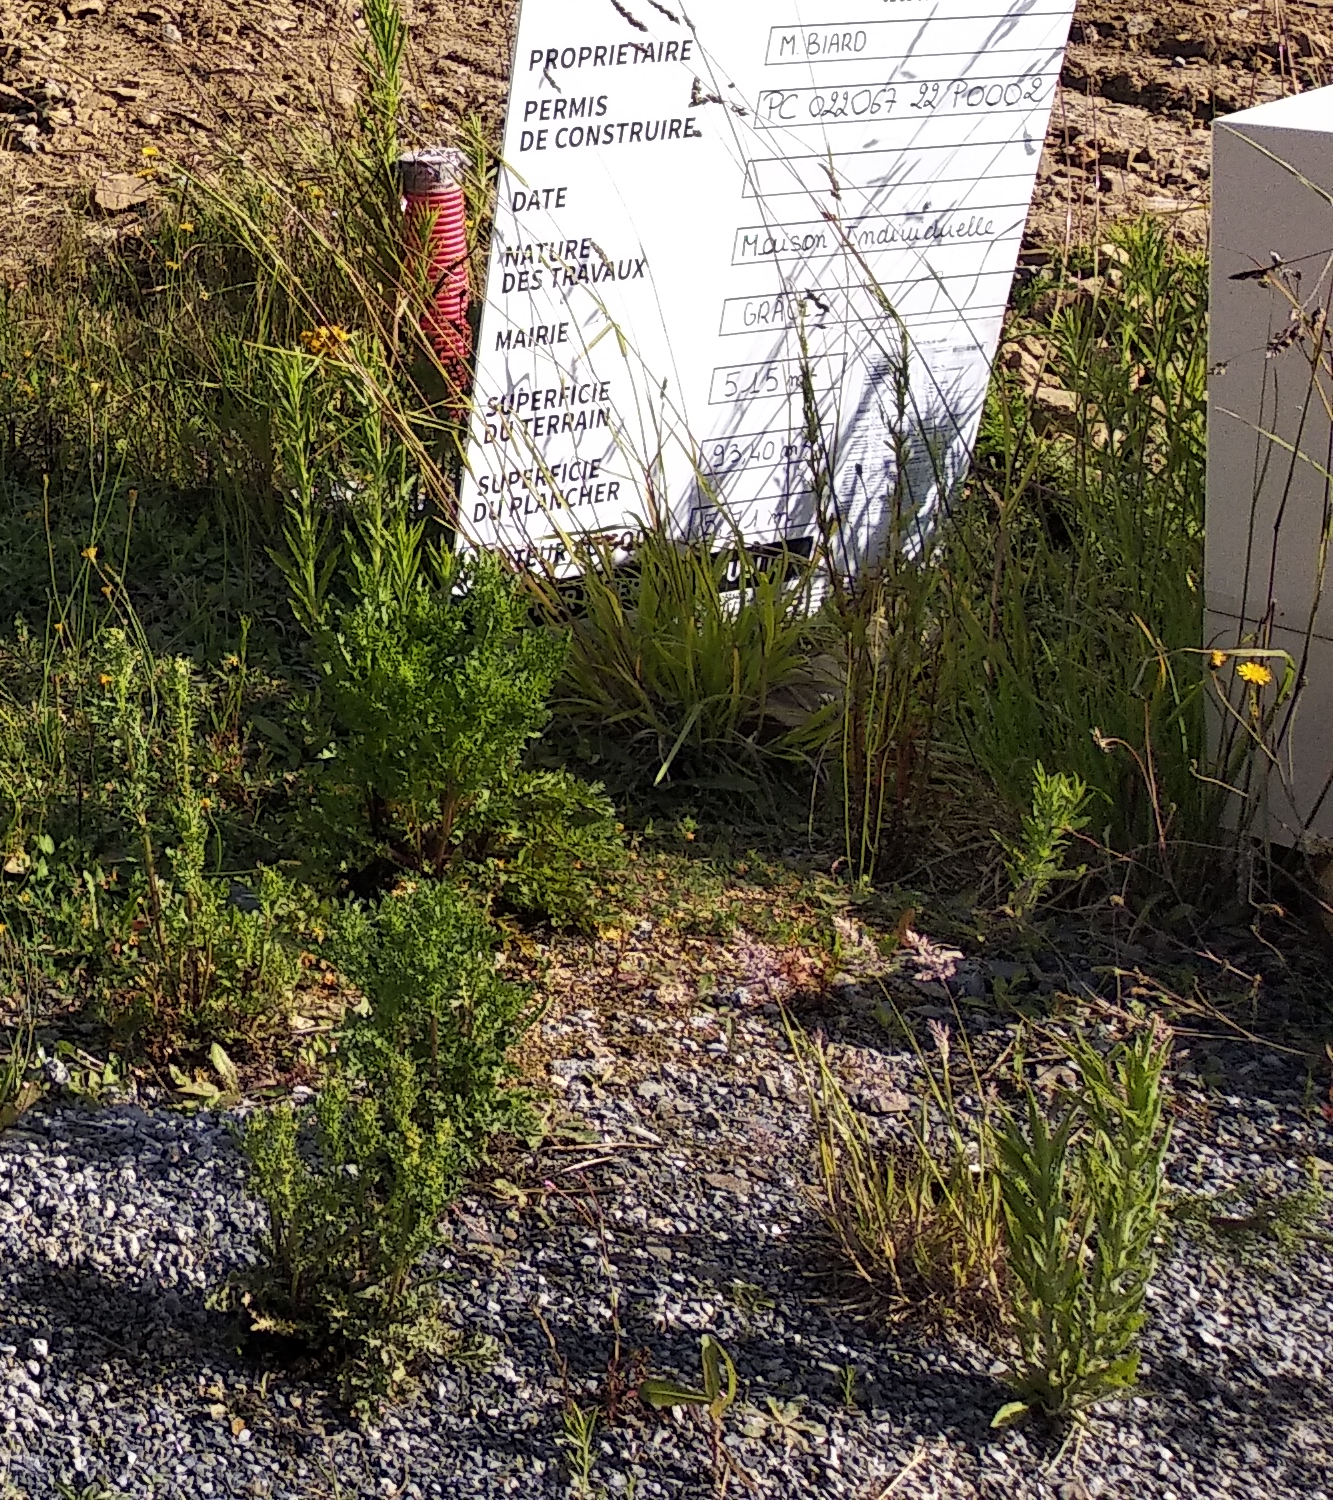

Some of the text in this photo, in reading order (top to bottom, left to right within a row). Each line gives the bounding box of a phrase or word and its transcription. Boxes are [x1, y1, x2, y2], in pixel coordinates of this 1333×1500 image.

[529, 40, 693, 71] PROPRIETAIRE
[806, 31, 867, 56] BIARD
[524, 95, 608, 122] PERMIS
[763, 91, 798, 120] PC
[910, 82, 939, 109] 22
[519, 117, 696, 152] DE CONSTRUIRE
[512, 187, 568, 212] DATE
[505, 238, 592, 267] NATURE
[742, 234, 828, 257] Maison
[502, 258, 647, 294] DES TRAVAUX
[495, 322, 569, 351] MAIRIE
[486, 379, 610, 417] SUPERFICIE
[484, 407, 611, 444] DU TERRAIN
[477, 458, 601, 496] SUPERFICIE
[473, 482, 620, 523] DU PLANCHER
